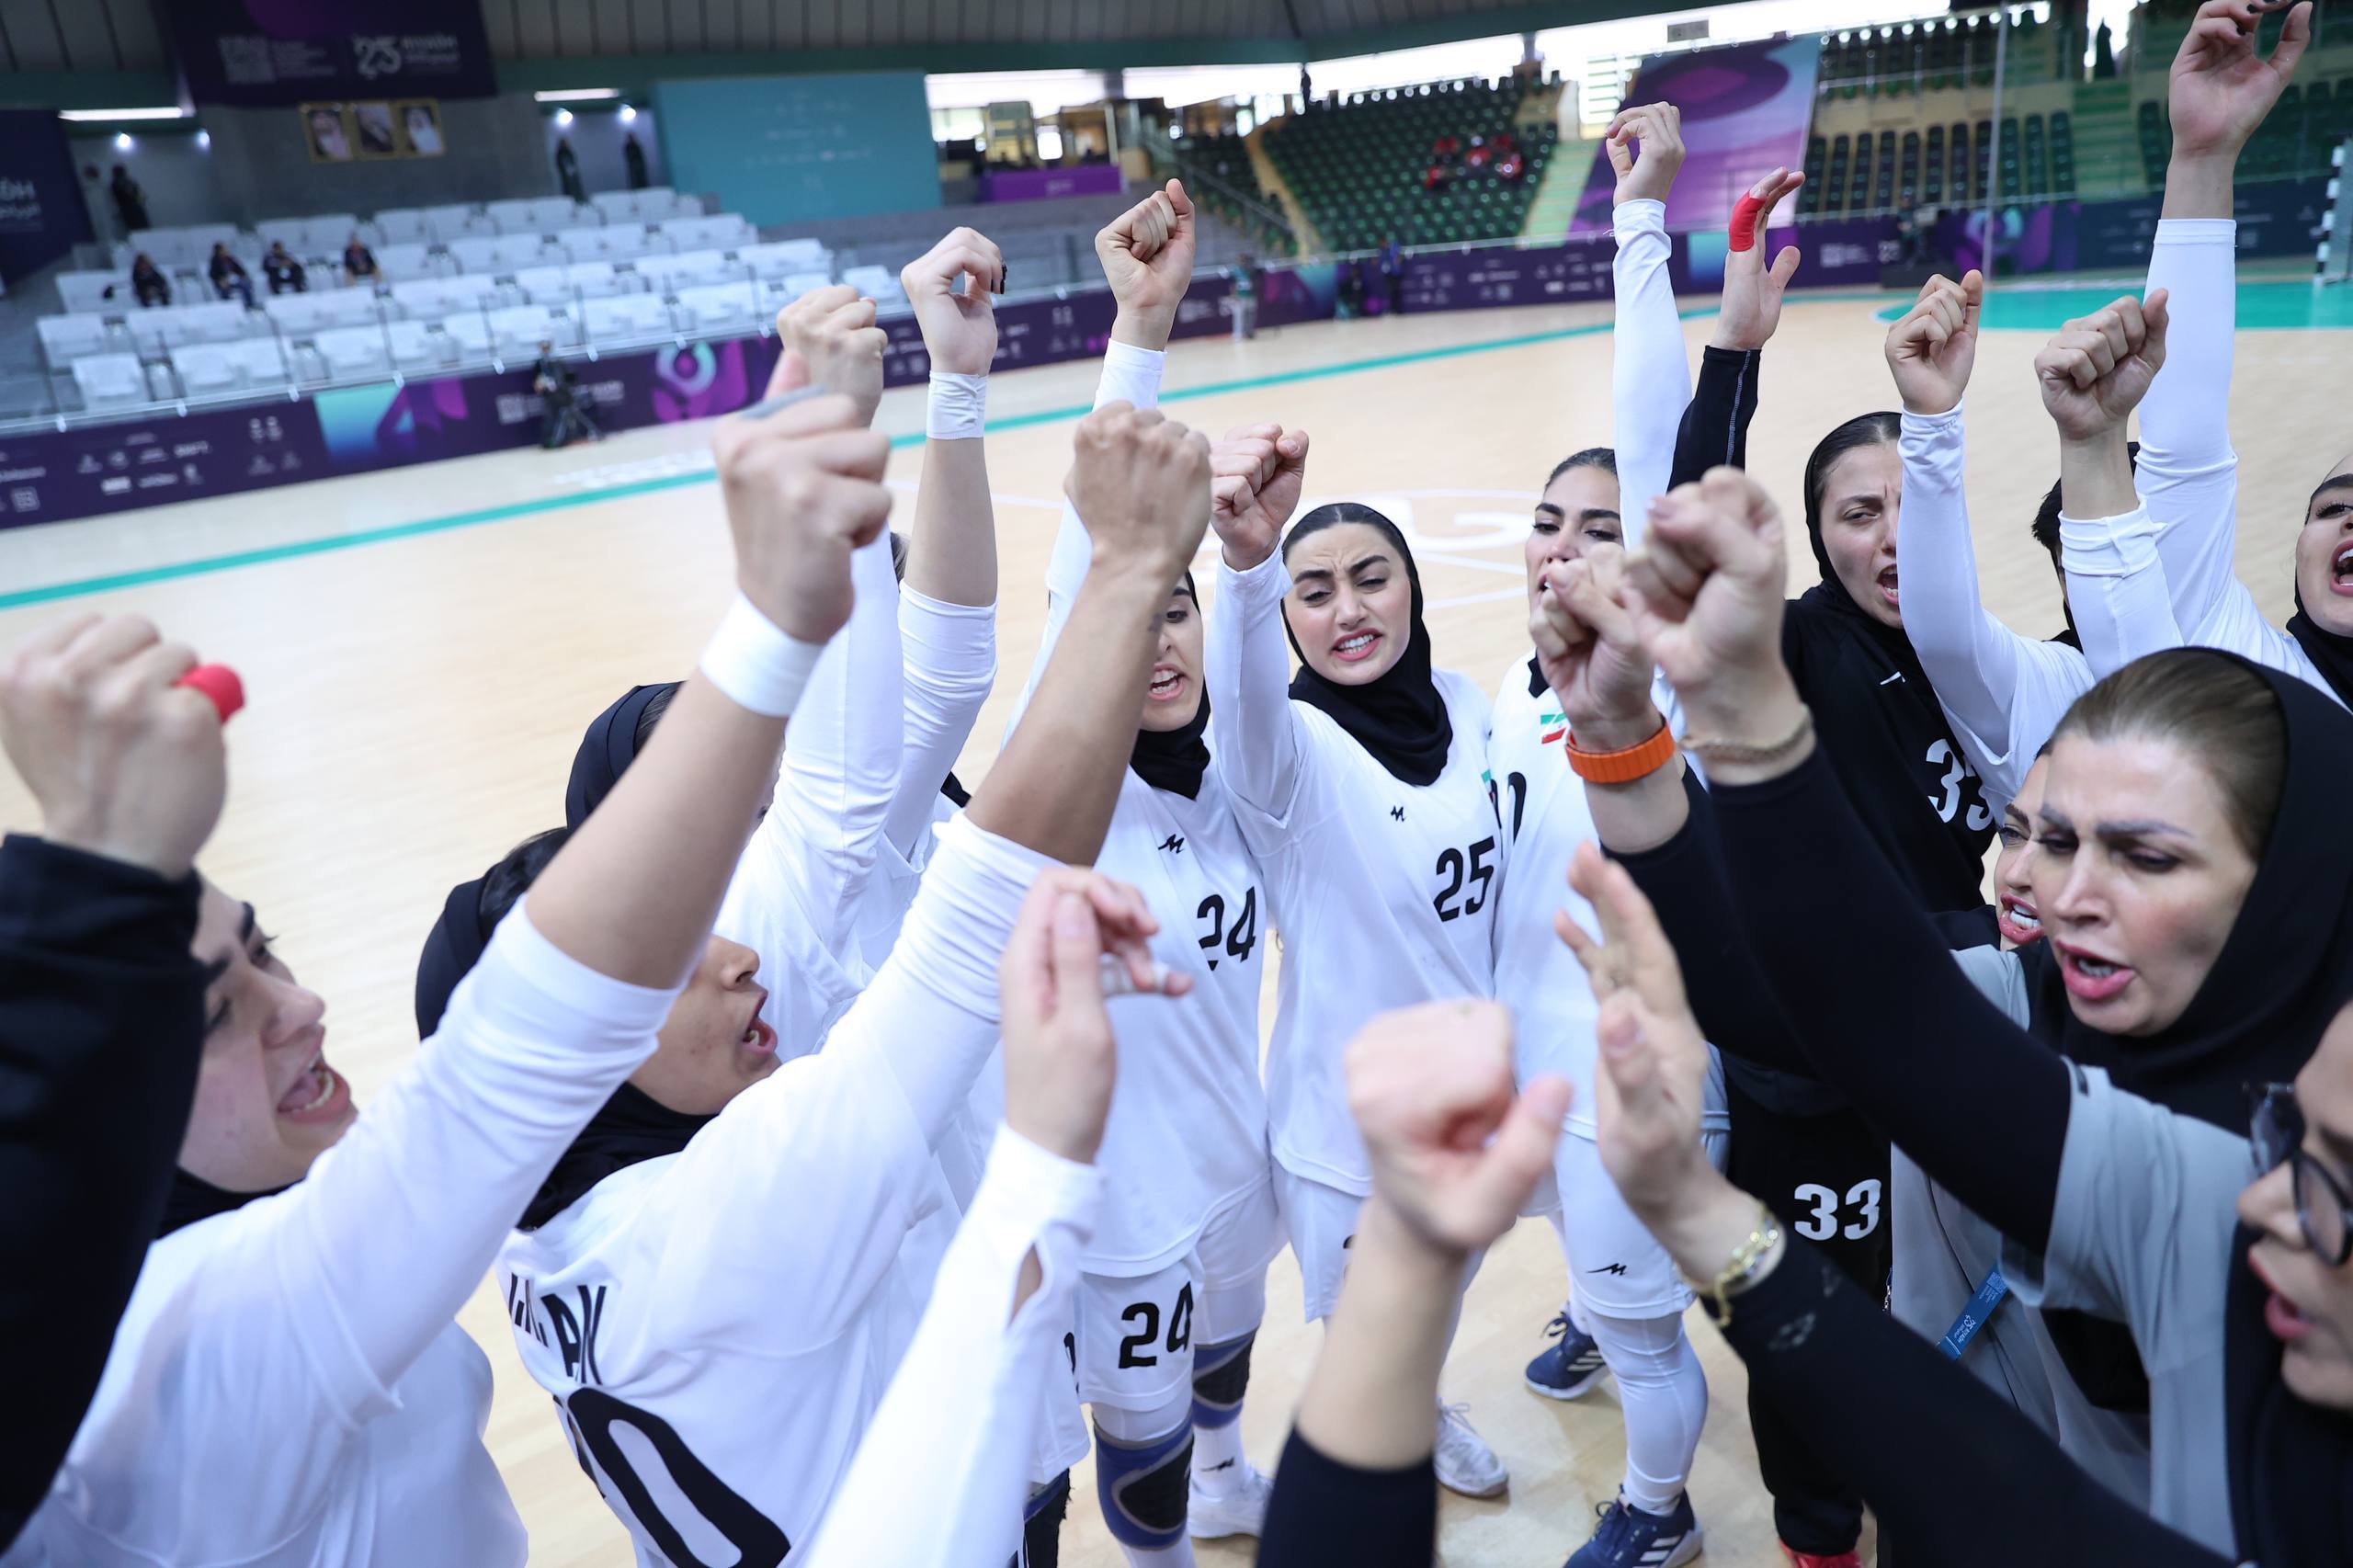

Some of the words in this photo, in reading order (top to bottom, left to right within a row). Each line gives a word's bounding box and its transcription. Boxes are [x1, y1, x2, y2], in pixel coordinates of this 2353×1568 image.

[1433, 836, 1495, 922] 25
[1197, 886, 1256, 971] 24
[1794, 1178, 1882, 1241] 33
[1118, 1280, 1194, 1369] 24
[552, 1387, 791, 1568] 0
